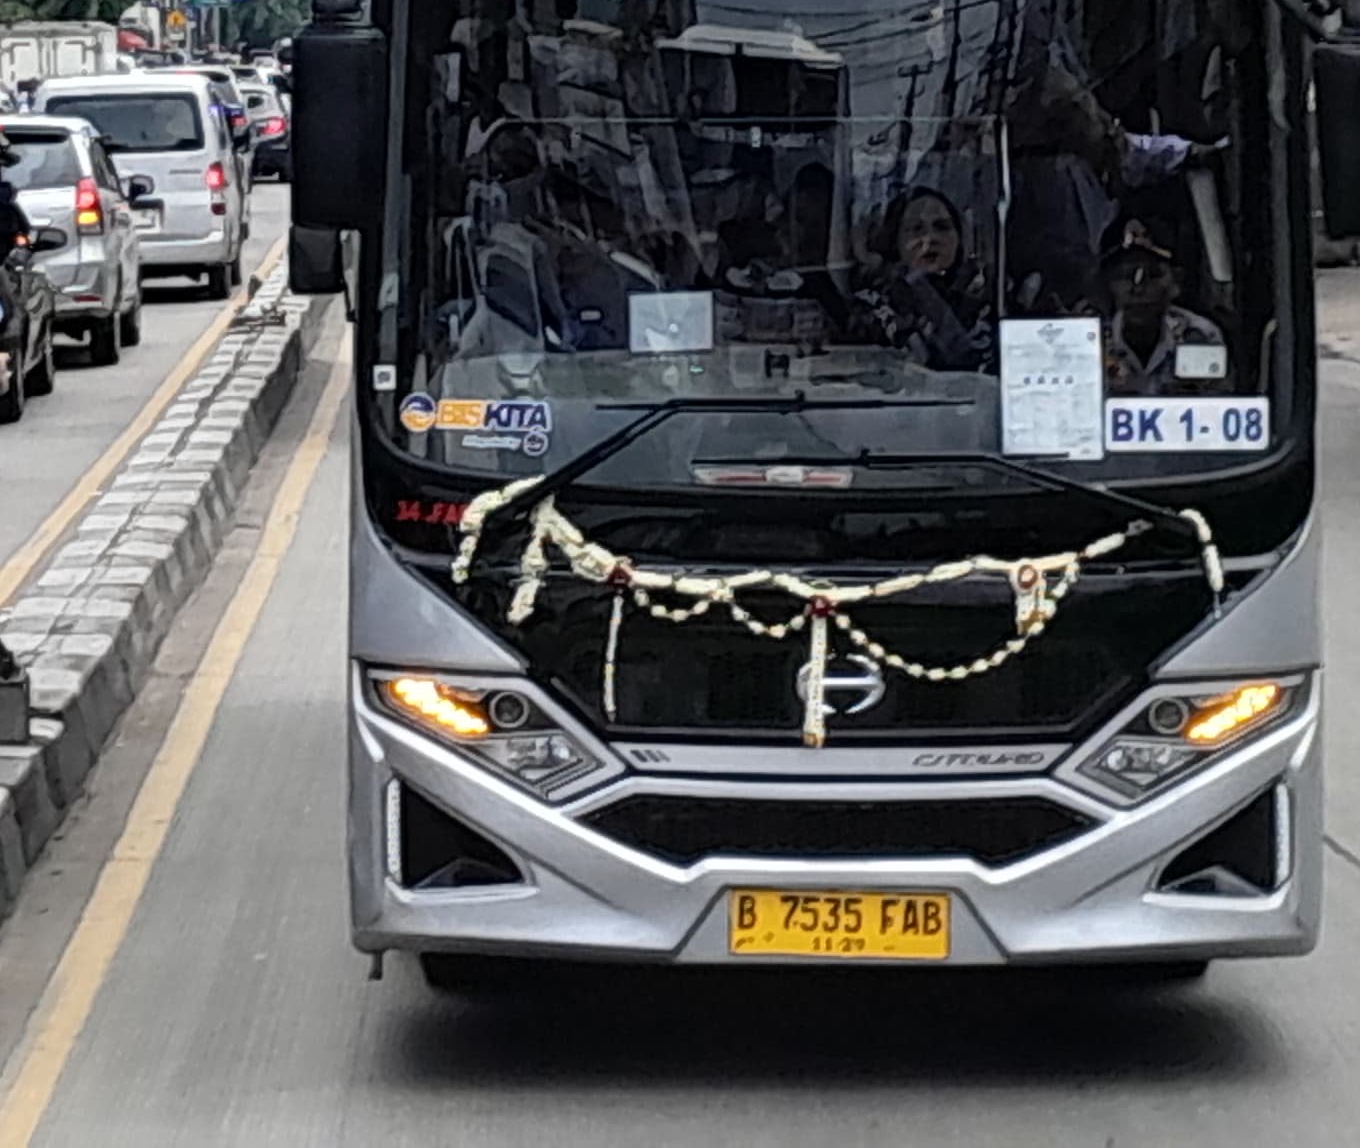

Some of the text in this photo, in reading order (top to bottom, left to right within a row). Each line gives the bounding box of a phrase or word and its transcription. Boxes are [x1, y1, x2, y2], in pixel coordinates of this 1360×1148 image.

[1111, 408, 1164, 442] BK
[1222, 408, 1263, 442] 08
[737, 895, 943, 936] B 7535 FAB
